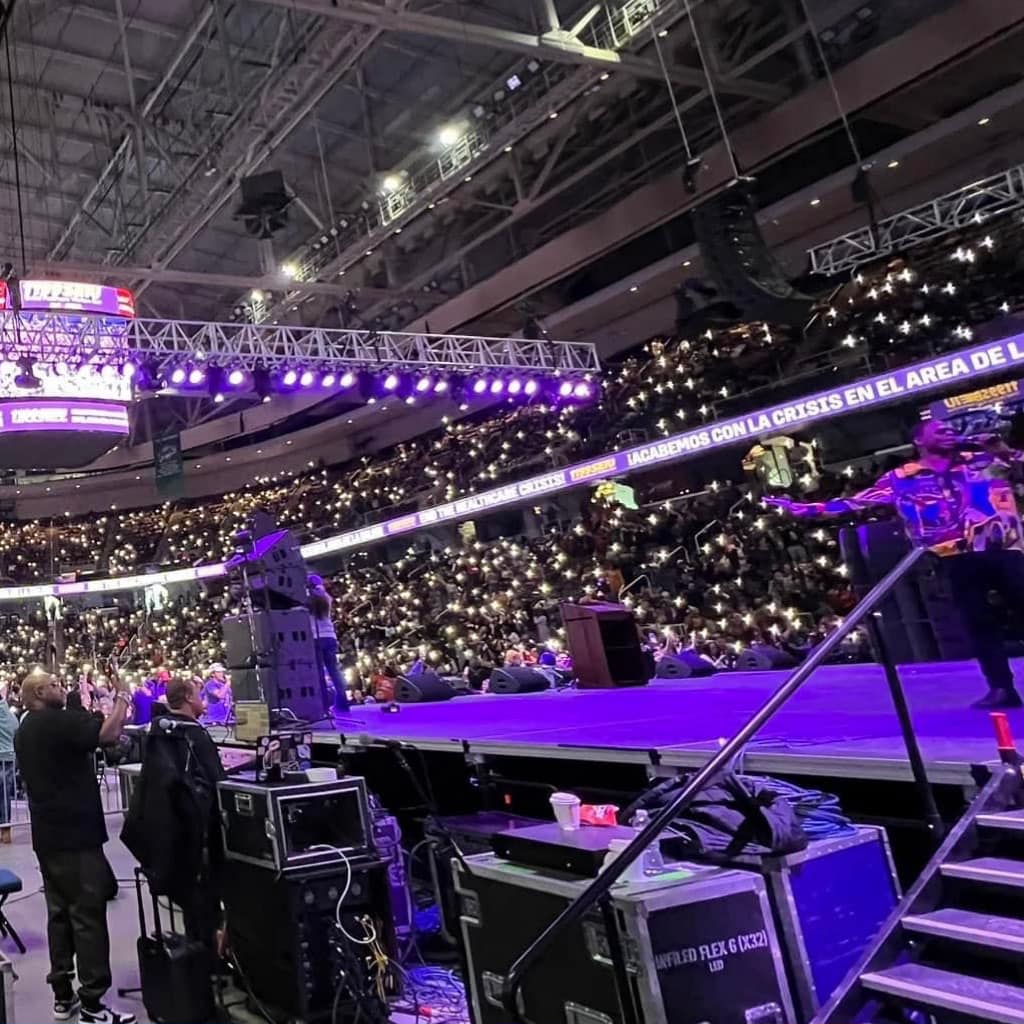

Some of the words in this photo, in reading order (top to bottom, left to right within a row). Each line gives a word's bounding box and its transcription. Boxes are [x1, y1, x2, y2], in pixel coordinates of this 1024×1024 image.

[711, 420, 746, 443] CON
[747, 413, 773, 433] LA
[772, 394, 844, 425] CRISIS
[845, 384, 875, 406] EN
[876, 377, 905, 397] EL
[906, 358, 970, 388] AREA
[971, 346, 1007, 371] DE
[699, 940, 728, 962] FLEX
[738, 929, 769, 953] (X32)
[709, 960, 724, 973] LED
